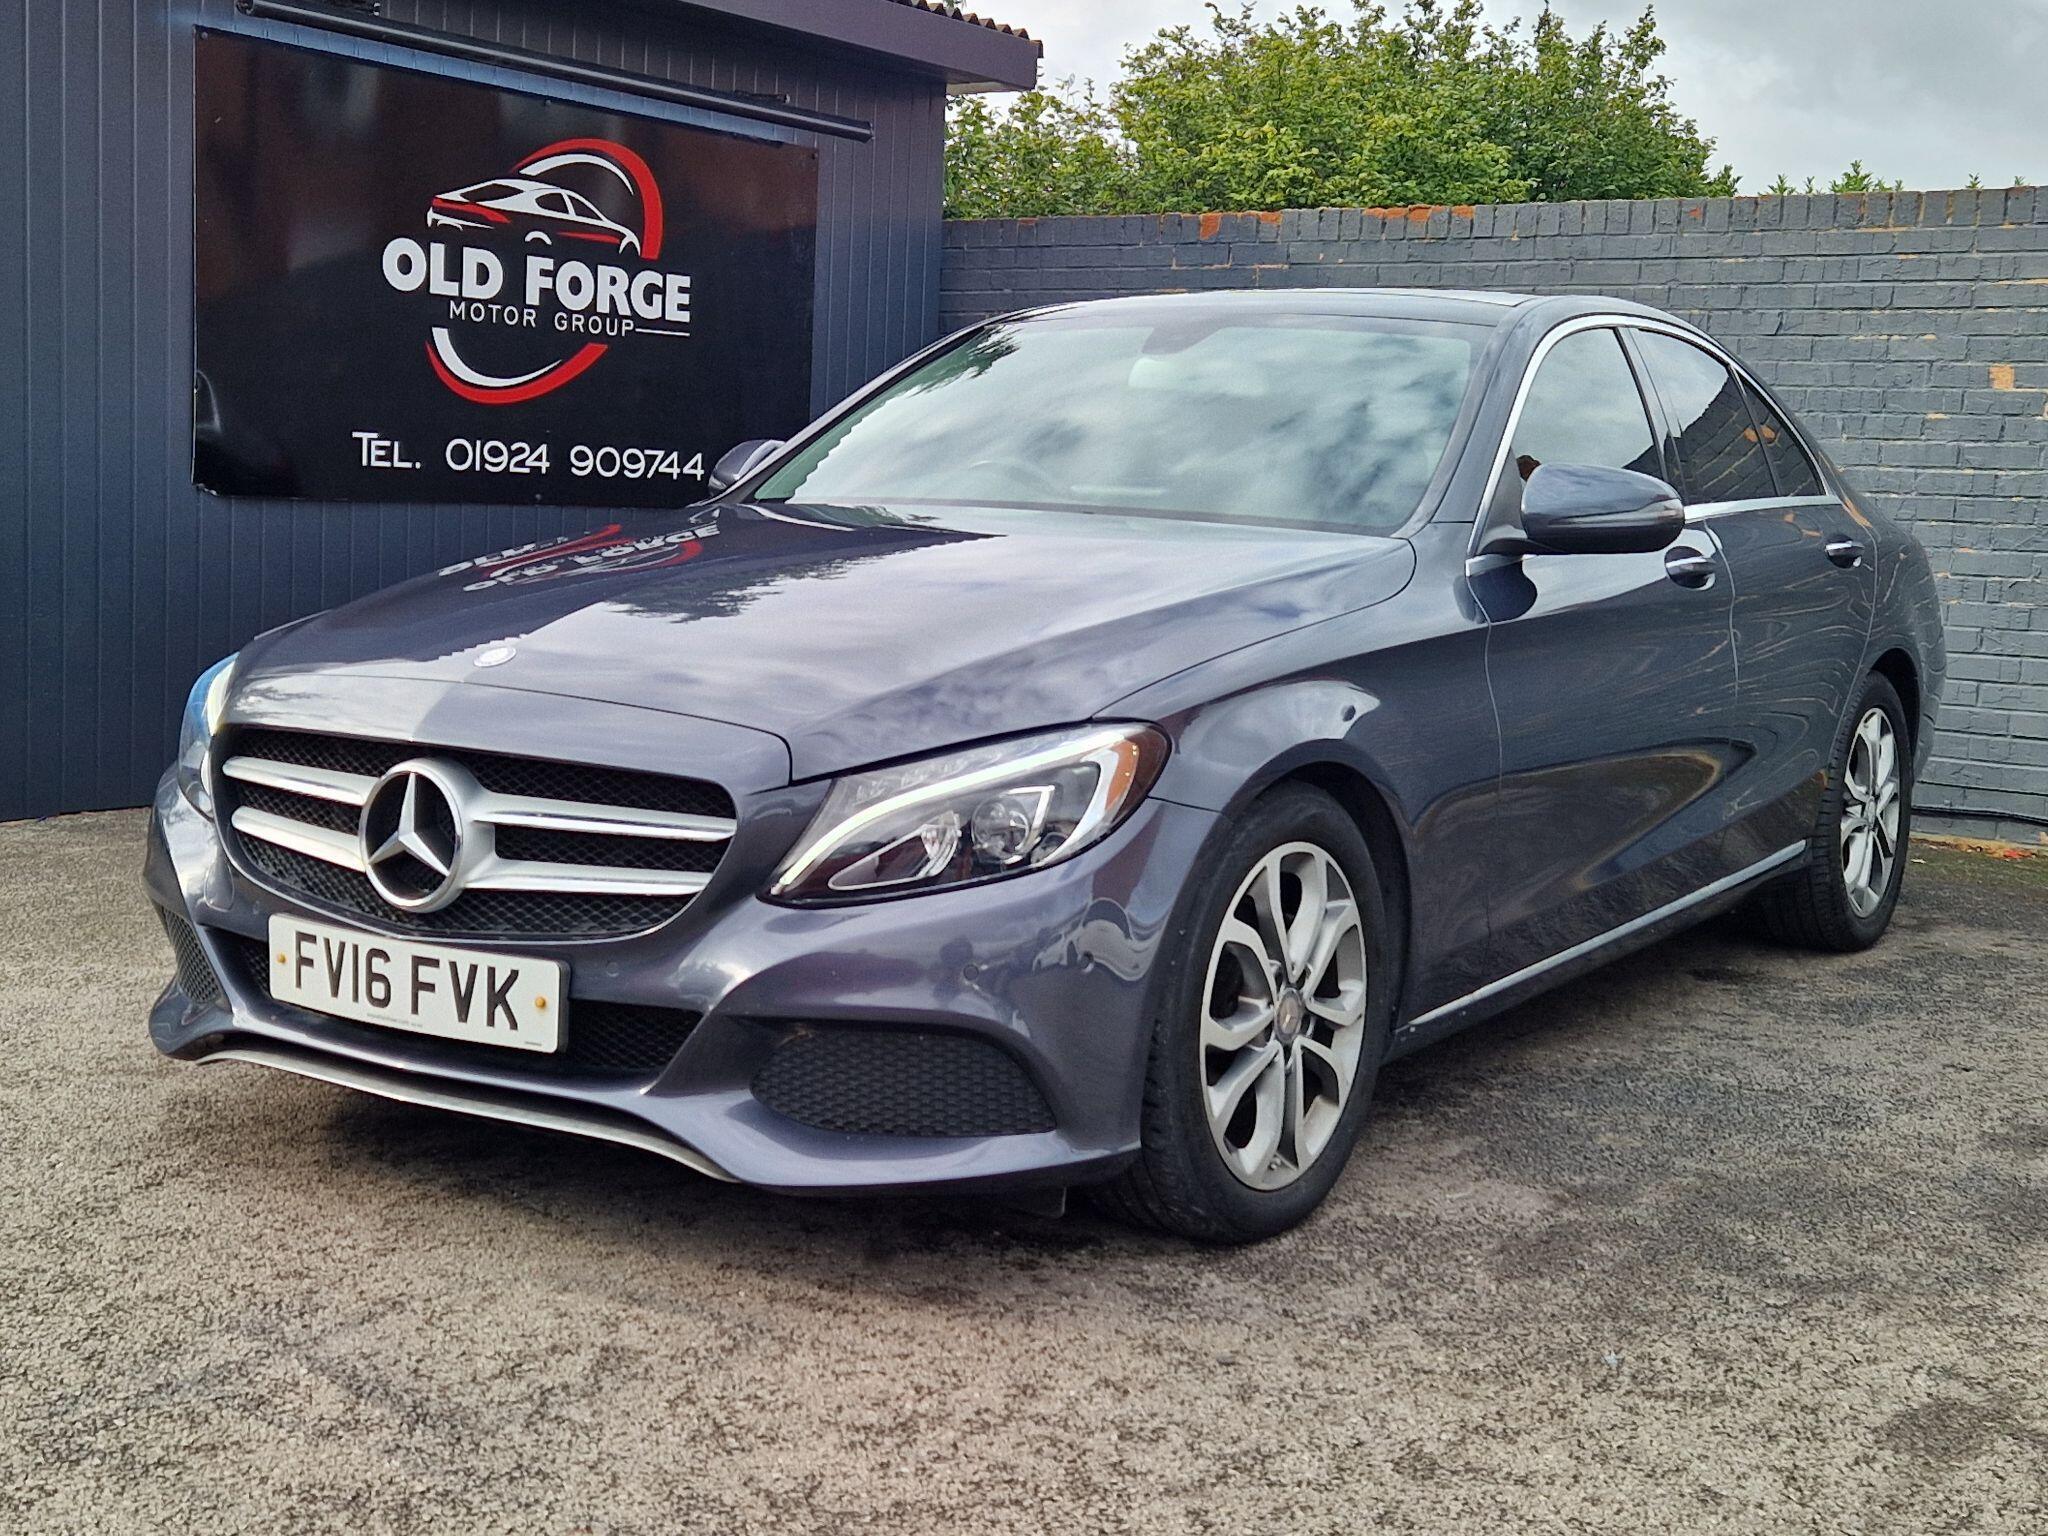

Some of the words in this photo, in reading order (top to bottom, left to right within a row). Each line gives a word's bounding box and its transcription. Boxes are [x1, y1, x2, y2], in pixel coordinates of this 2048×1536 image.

[382, 237, 503, 299] OLD
[525, 255, 691, 322] FORGE
[449, 300, 537, 328] MOTOR
[554, 312, 635, 337] GROUP
[352, 431, 421, 469] TEL.
[445, 438, 550, 474] 01924
[570, 445, 705, 480] 909744
[295, 931, 392, 1009] FV16
[411, 954, 520, 1031] FVK
